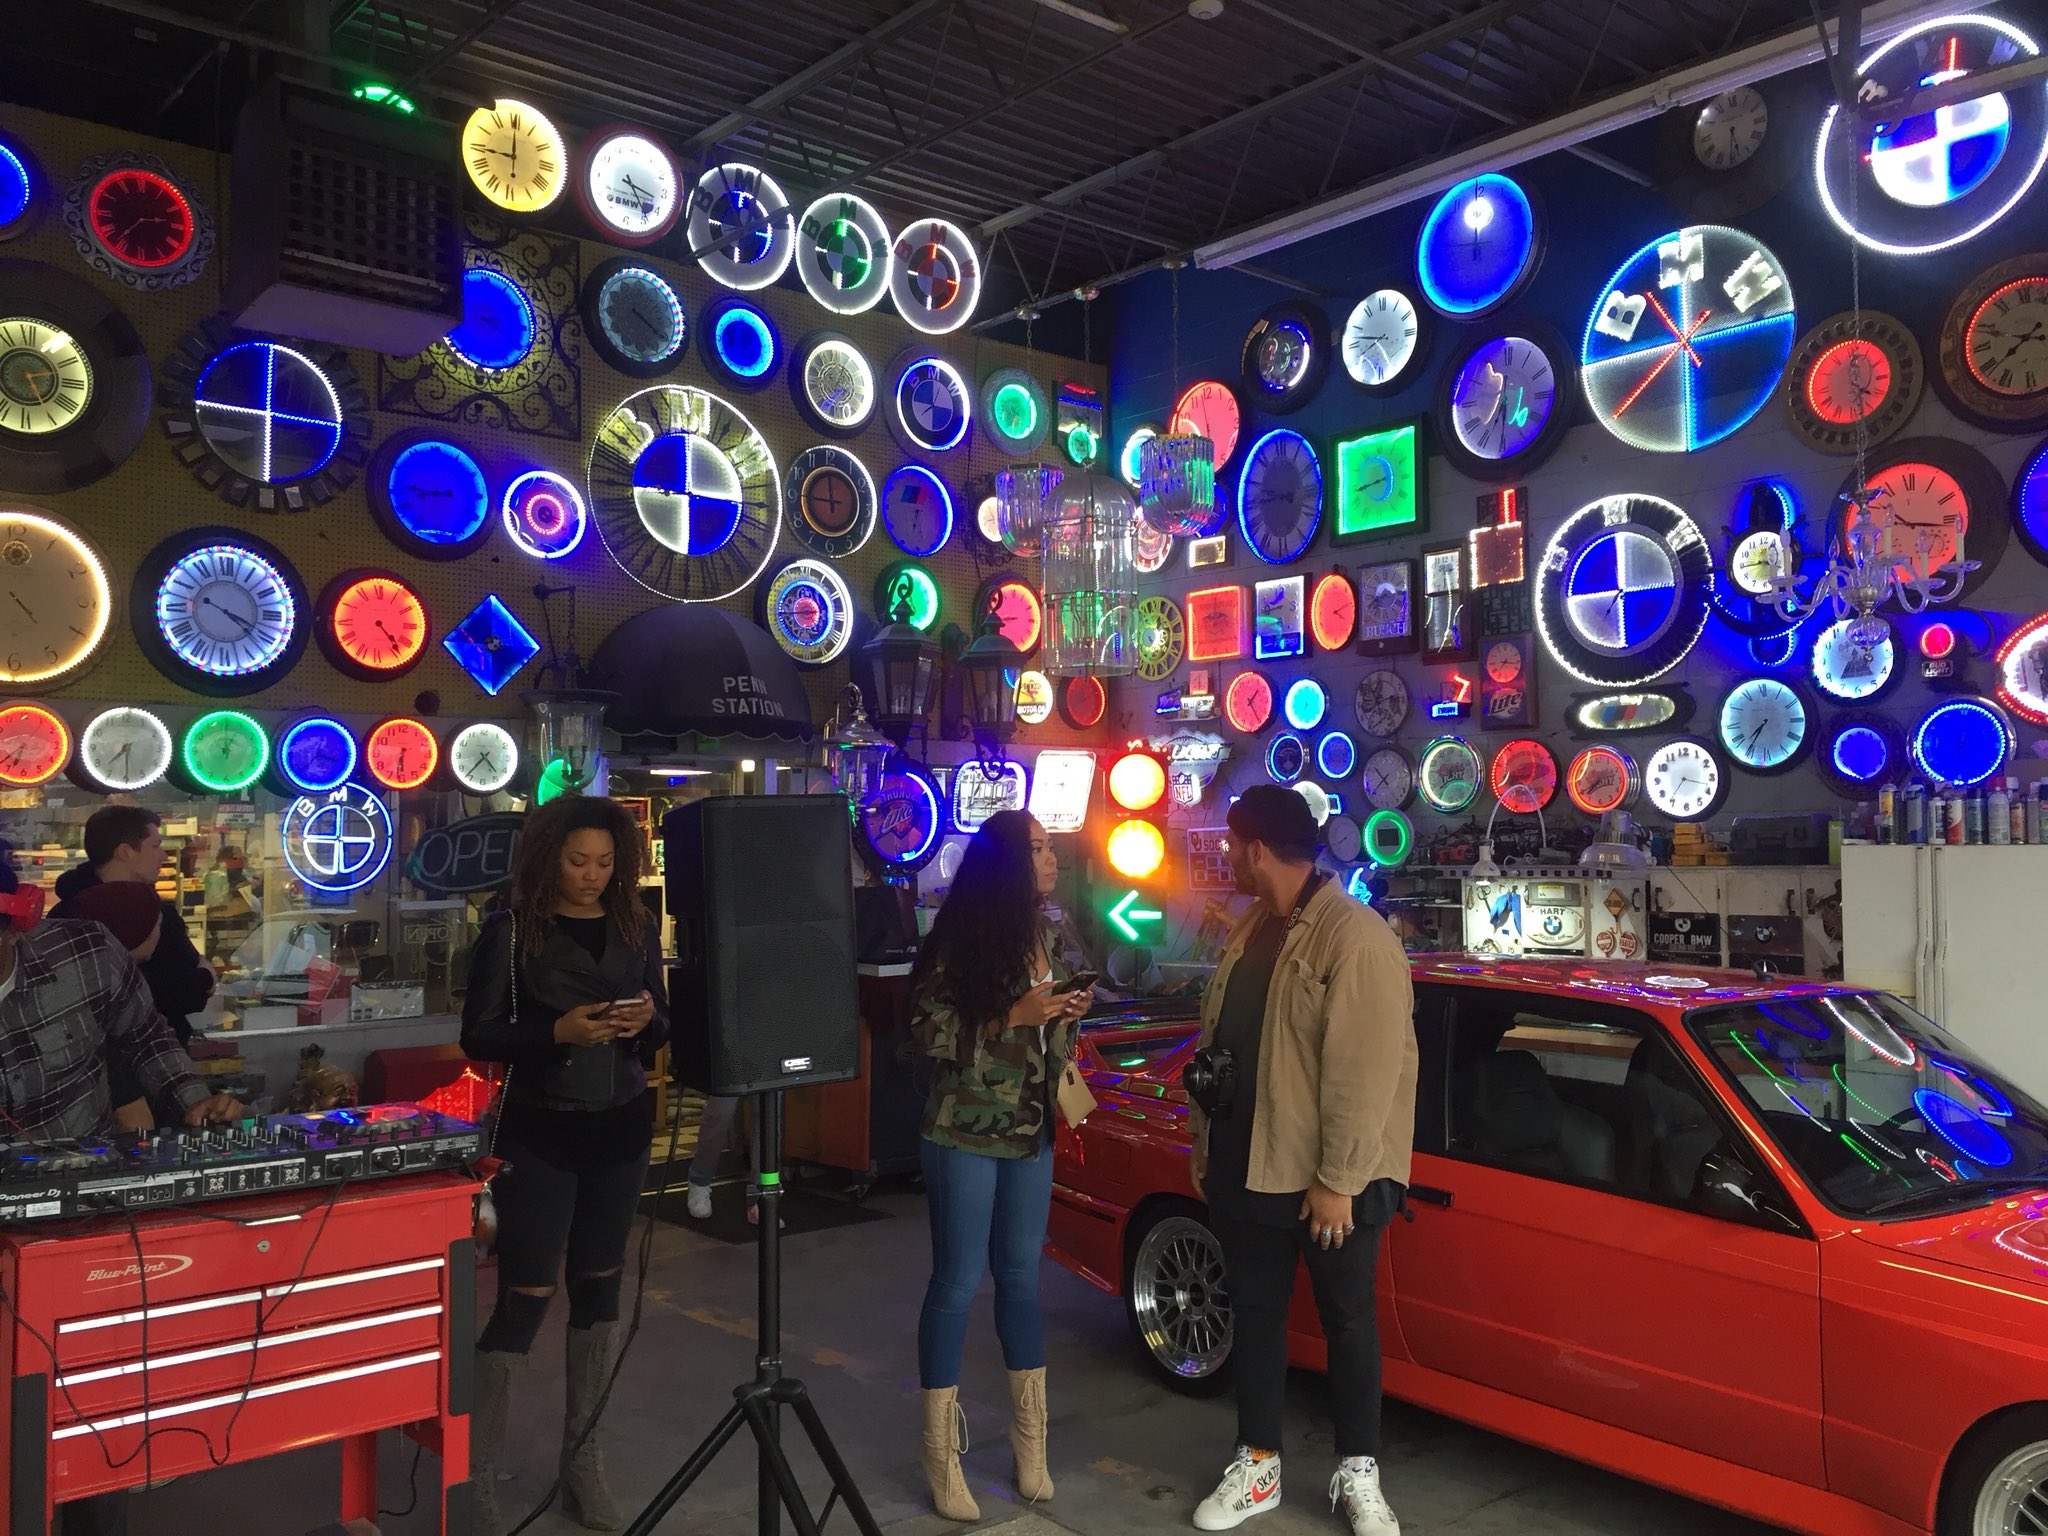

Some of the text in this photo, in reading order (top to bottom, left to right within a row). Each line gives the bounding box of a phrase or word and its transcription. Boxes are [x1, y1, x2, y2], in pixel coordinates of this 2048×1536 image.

[615, 196, 639, 209] BMW
[801, 197, 889, 259] BMW
[894, 222, 976, 279] BMW
[1594, 233, 1782, 342] BMW
[907, 366, 962, 397] BMW
[1202, 386, 1212, 400] 12
[1191, 395, 1199, 409] 11
[1227, 398, 1235, 411] 2
[808, 453, 816, 468] 11
[825, 449, 836, 467] 12
[793, 467, 805, 480] 10
[787, 488, 798, 501] 9
[793, 513, 804, 528] 8
[807, 530, 816, 545] 7
[846, 536, 853, 549] 5
[825, 538, 835, 553] 6
[1366, 621, 1406, 638] BUSCH
[722, 675, 768, 695] PENN
[711, 697, 784, 717] STATION
[387, 728, 395, 737] 11
[398, 724, 409, 734] 12
[376, 737, 388, 746] 10
[420, 738, 428, 747] 2
[1666, 752, 1675, 762] 11
[1677, 747, 1690, 758] 12
[376, 761, 384, 771] 8
[419, 762, 427, 770] 4
[1657, 763, 1668, 773] 10
[1703, 758, 1710, 768] 2
[386, 771, 393, 780] 7
[411, 771, 419, 780] 5
[1654, 776, 1661, 786] 9
[1708, 773, 1716, 782] 3
[1174, 785, 1192, 799] NFL
[1705, 787, 1711, 796] 4
[296, 786, 379, 818] BMW
[1669, 797, 1676, 808] 7
[1683, 802, 1690, 812] 6
[1696, 796, 1703, 807] 5
[1288, 907, 1302, 928] EOS
[1539, 907, 1566, 916] HART
[1653, 933, 1713, 946] COOPER BMW
[1256, 1463, 1281, 1491] SKATE
[1232, 1491, 1254, 1513] NIKE
